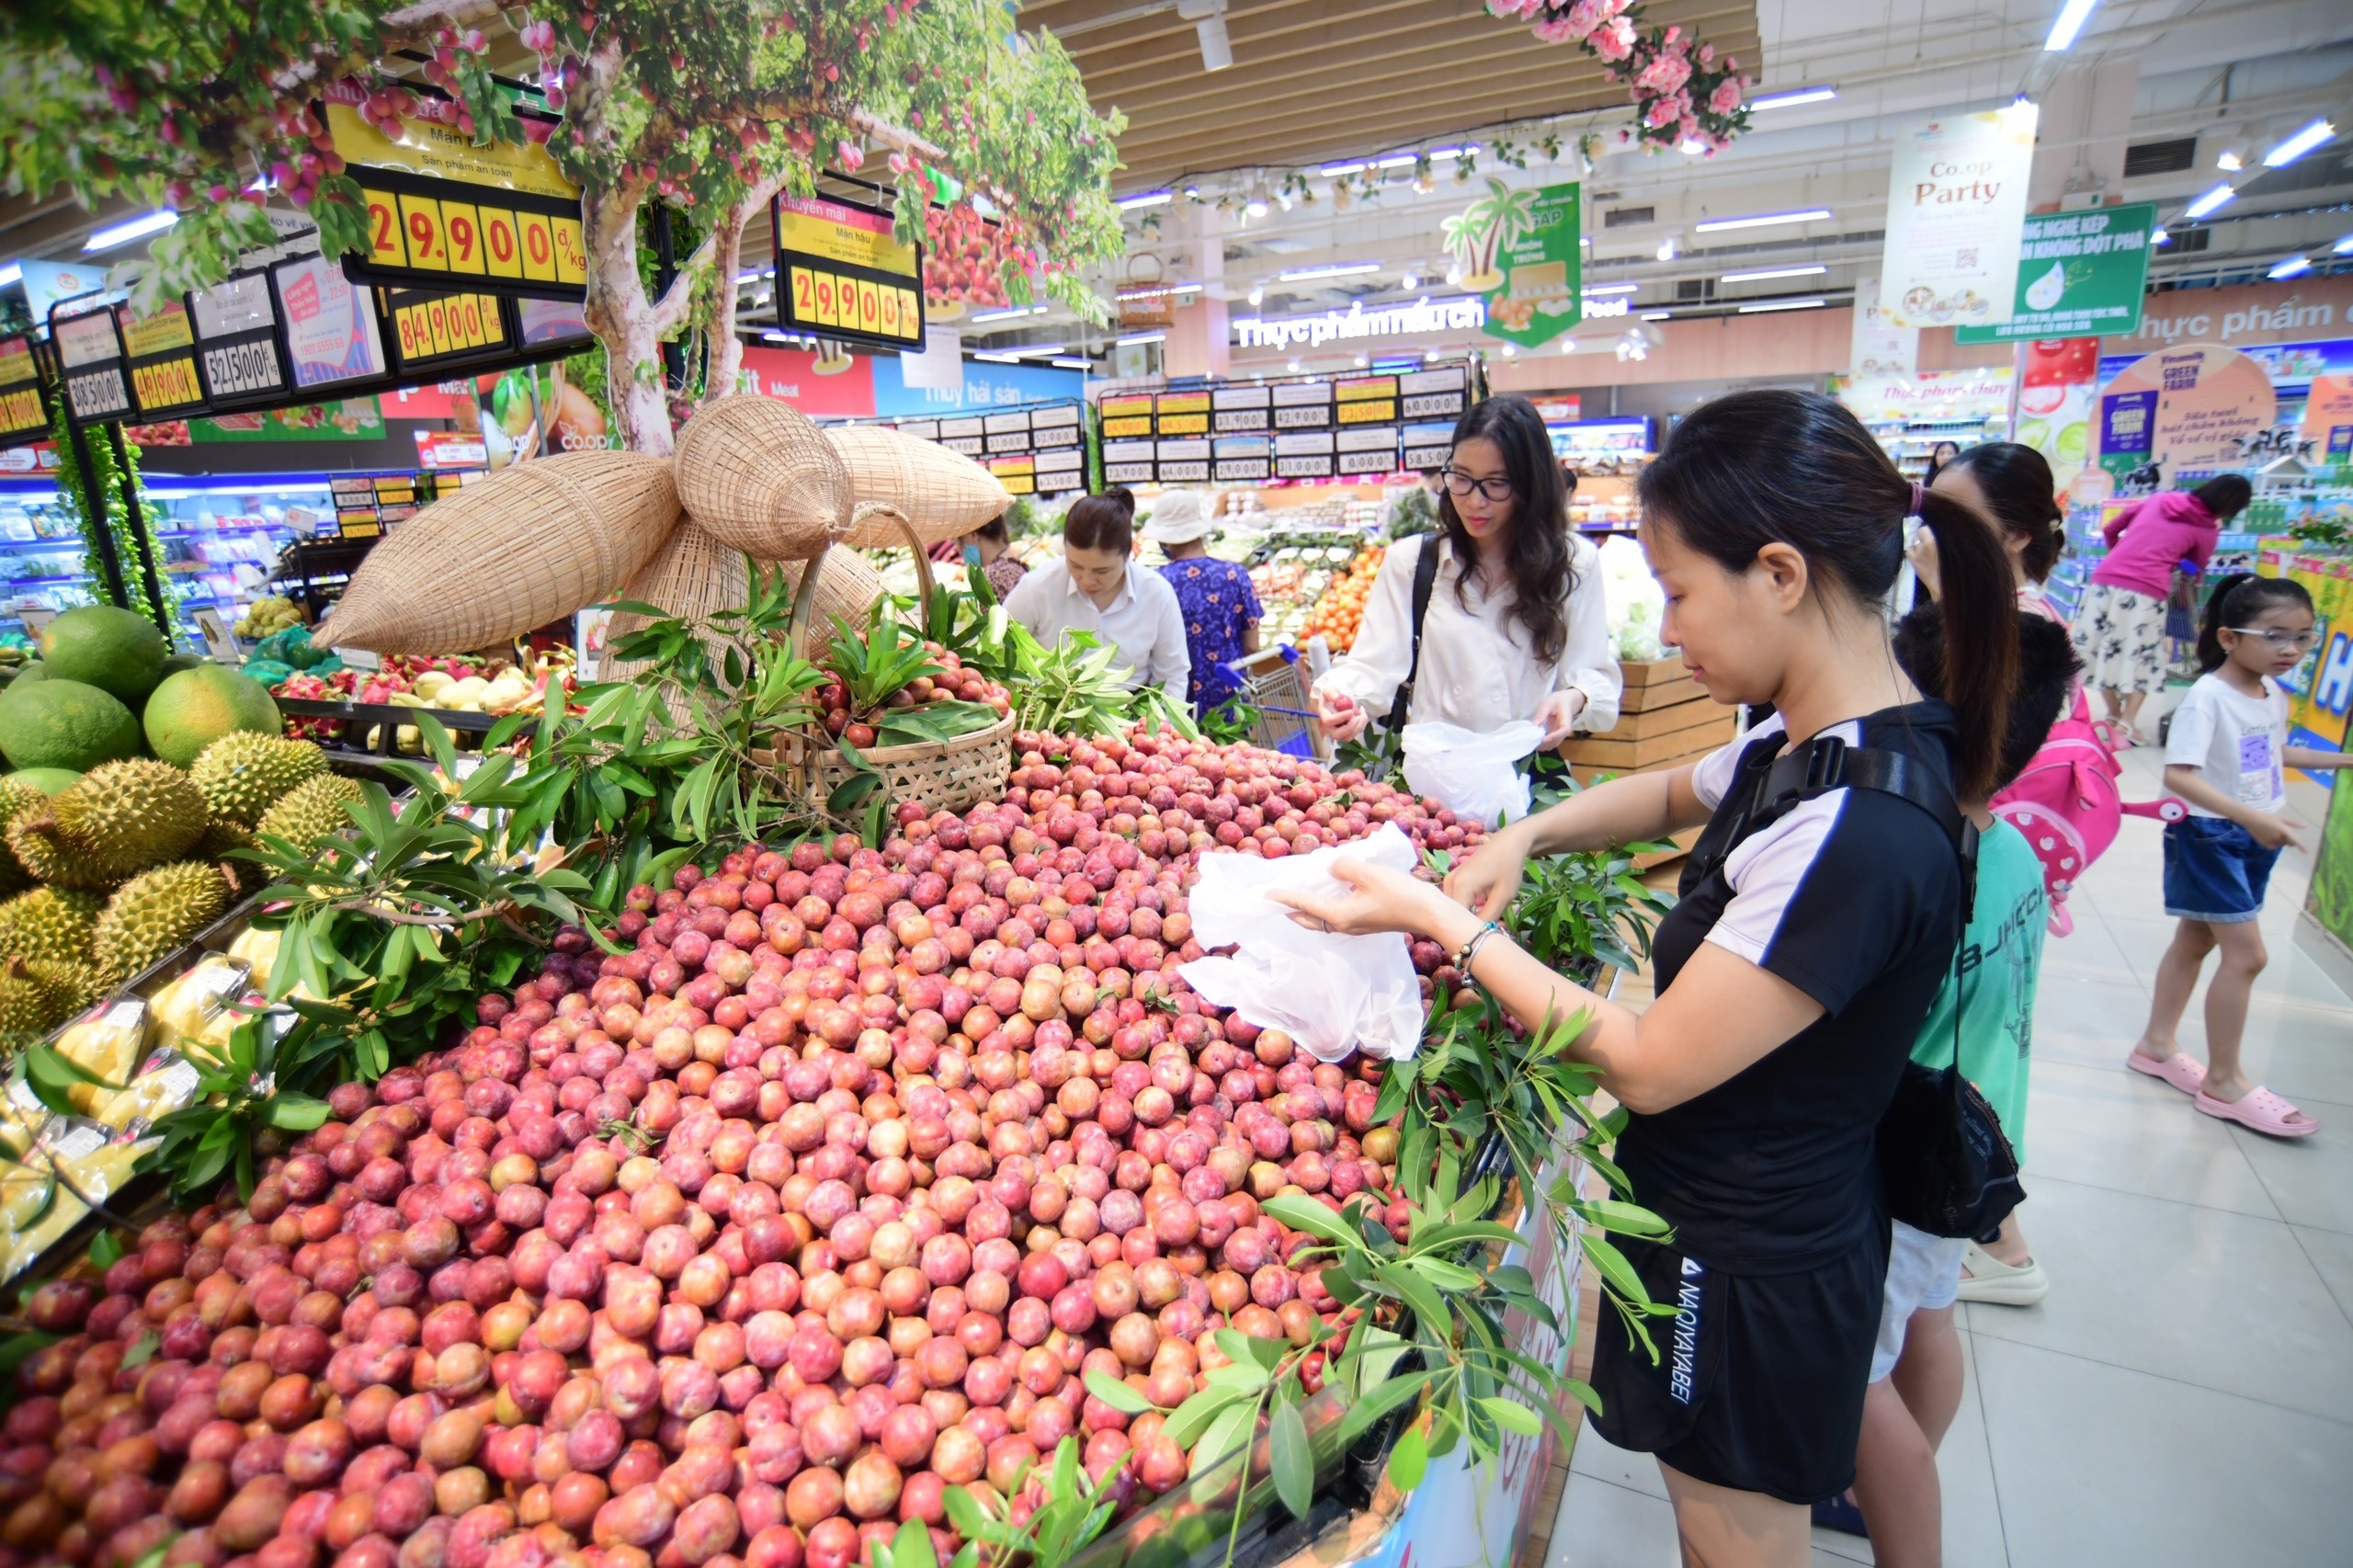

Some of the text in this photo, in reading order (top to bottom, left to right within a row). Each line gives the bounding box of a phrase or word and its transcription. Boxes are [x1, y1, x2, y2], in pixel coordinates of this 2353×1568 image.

[476, 165, 489, 174] an
[1913, 180, 2001, 207] Party
[369, 204, 550, 266] 29.900
[796, 274, 897, 324] 29.900
[2121, 312, 2211, 345] hực
[2220, 294, 2333, 341] phẩm
[401, 302, 479, 351] 84.900
[209, 348, 264, 385] 52.500
[771, 381, 800, 398] Meat
